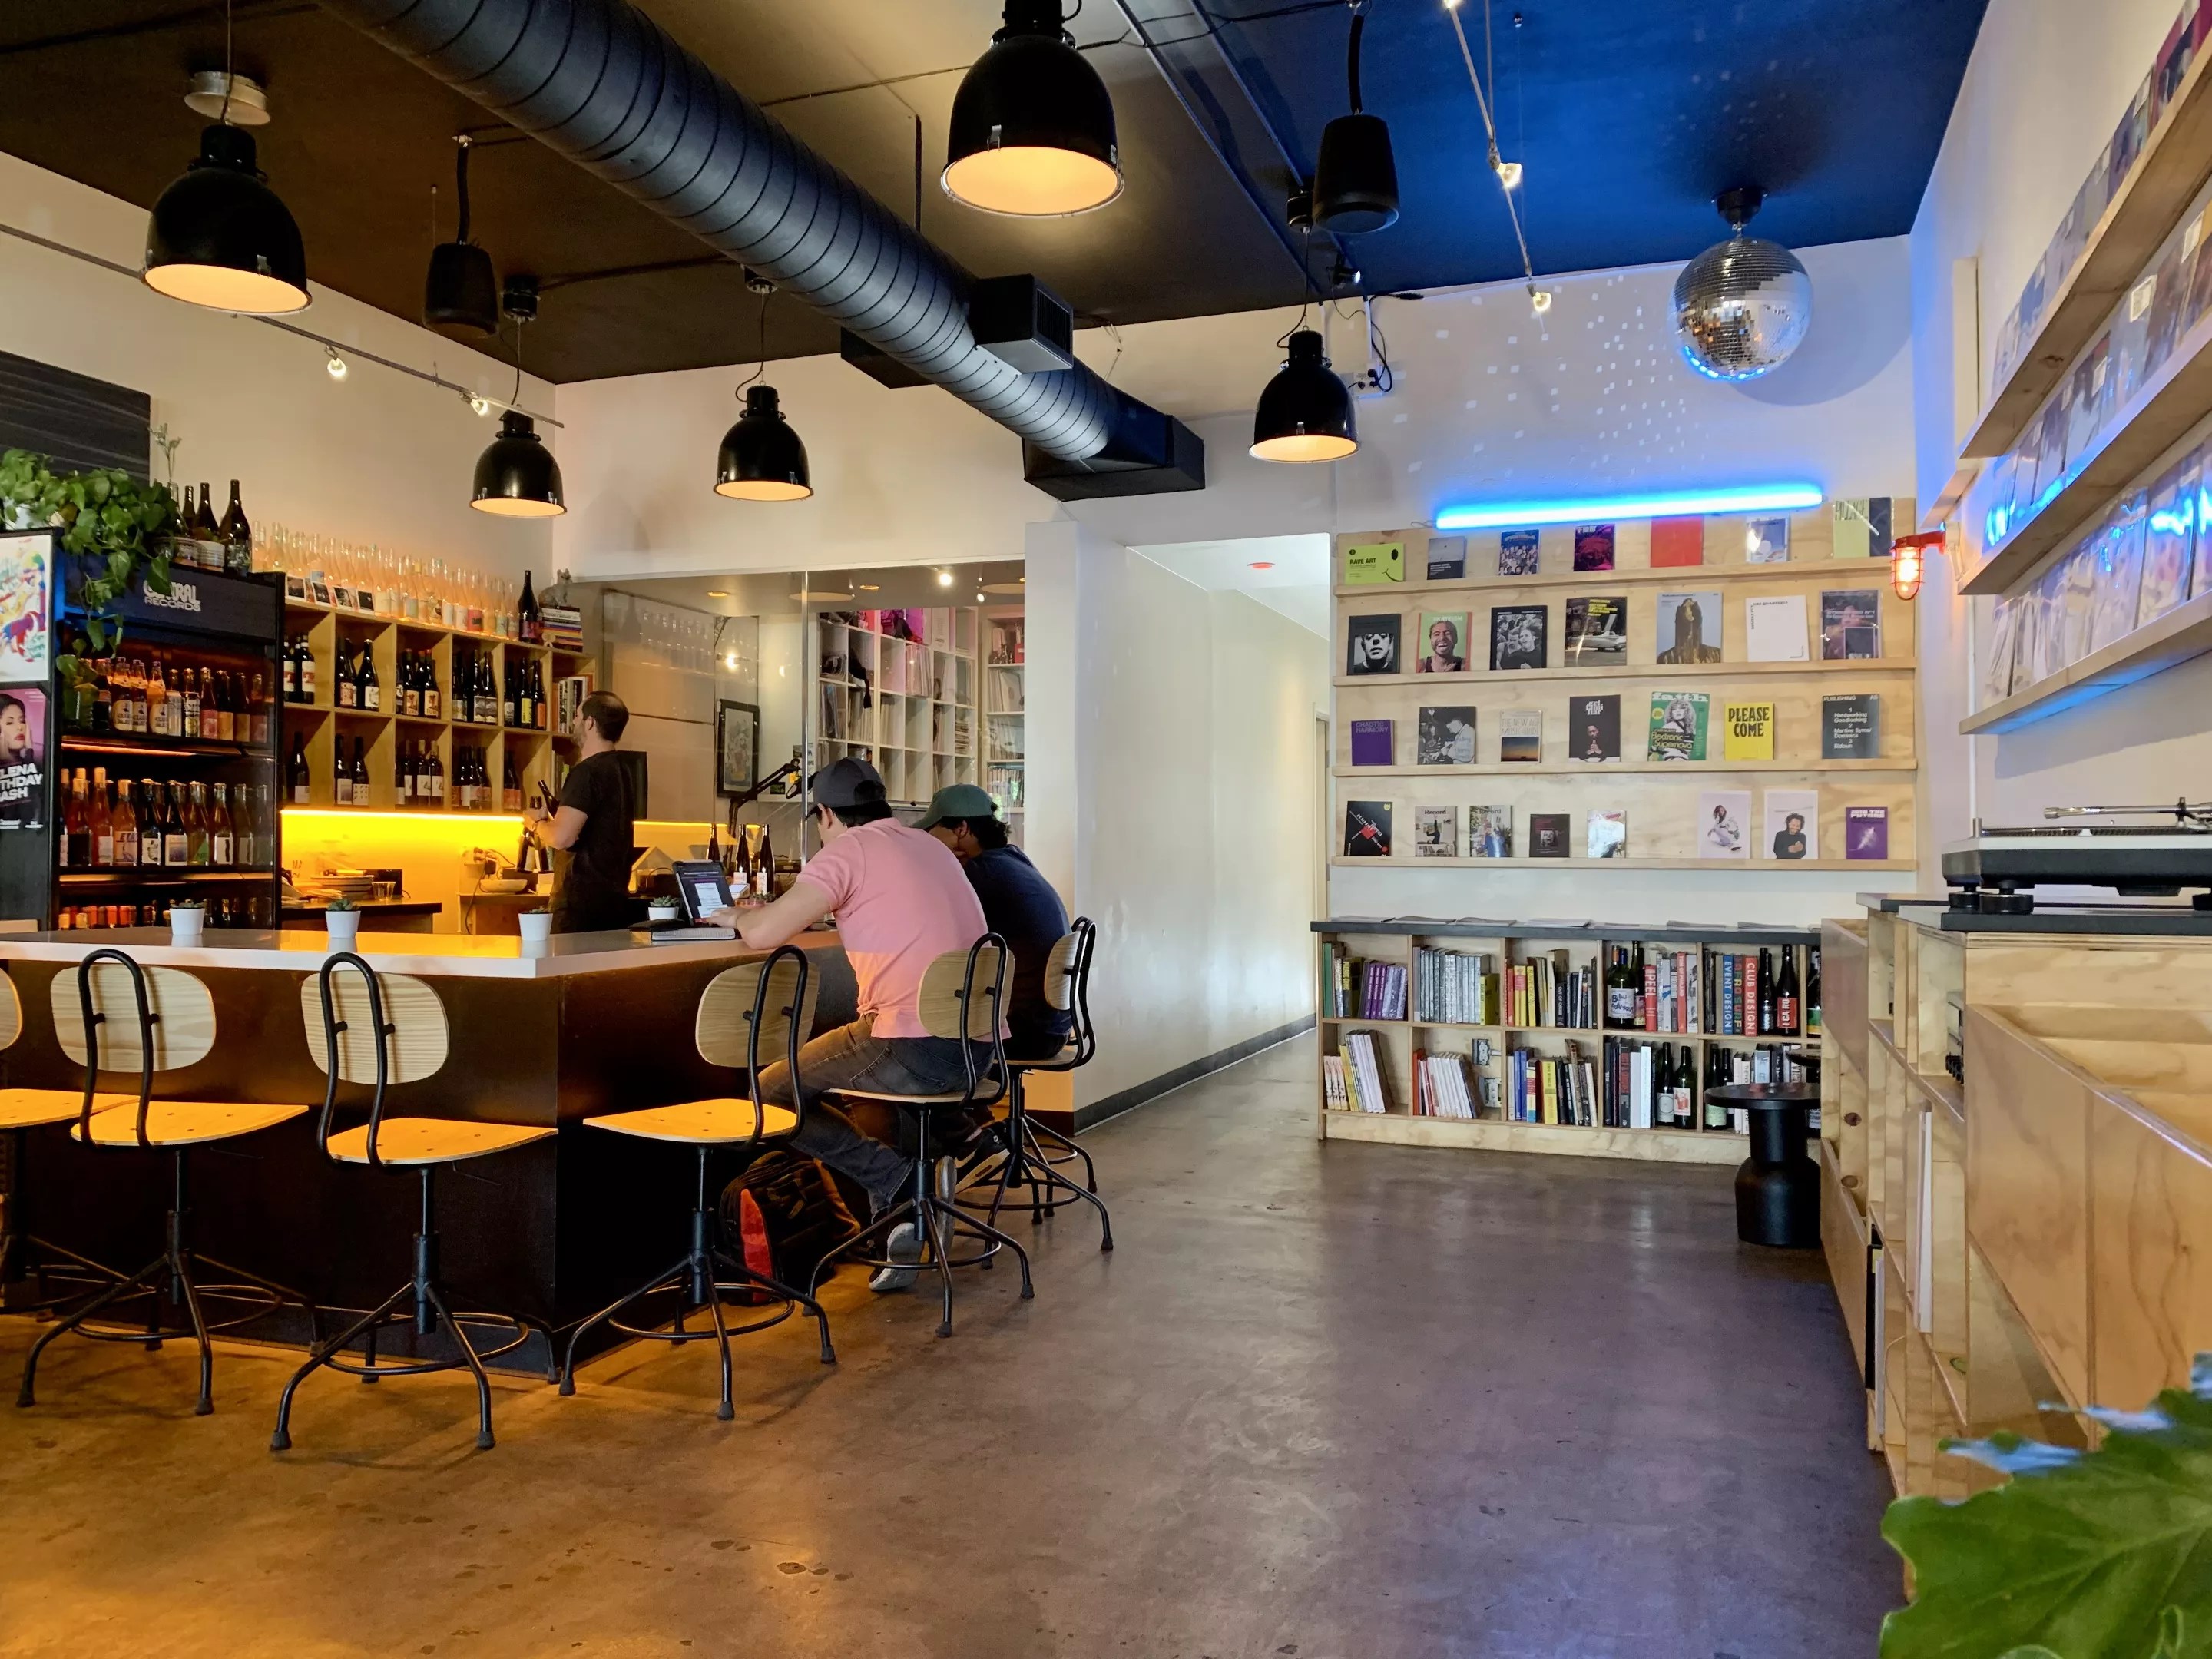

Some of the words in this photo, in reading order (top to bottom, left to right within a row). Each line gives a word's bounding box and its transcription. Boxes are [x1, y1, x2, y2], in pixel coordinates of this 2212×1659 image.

[143, 580, 201, 605] CTRAL
[144, 596, 201, 612] RECORDS
[1652, 692, 1709, 702] faith
[1728, 707, 1770, 722] PLEASE
[1513, 718, 1528, 727] NEW
[1734, 722, 1764, 737] COME
[1651, 732, 1683, 741] Electronic
[1654, 740, 1693, 750] Supernova
[0, 786, 28, 802] ASH
[1747, 962, 1756, 987] CLUB
[1747, 992, 1756, 1029] DESIGN
